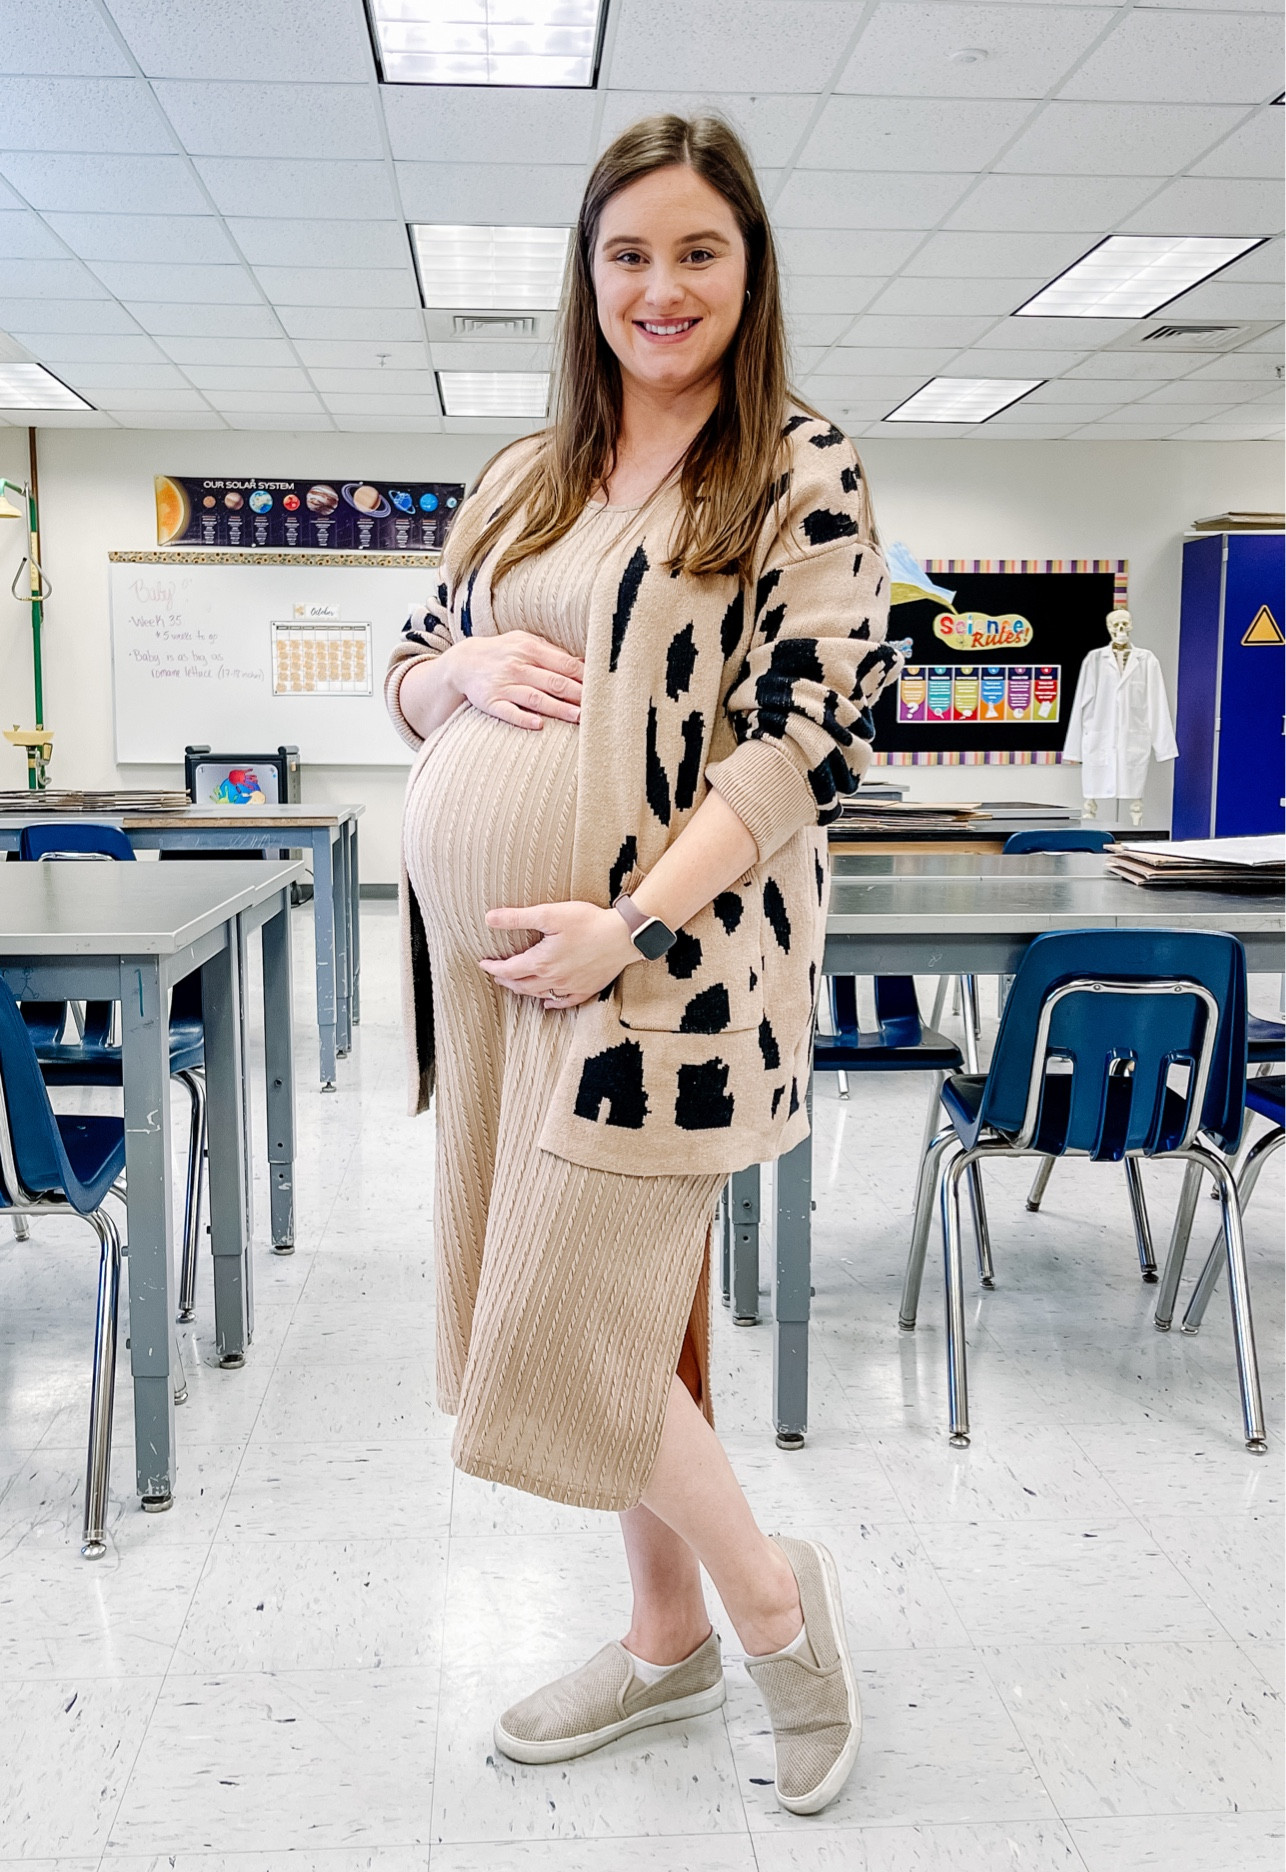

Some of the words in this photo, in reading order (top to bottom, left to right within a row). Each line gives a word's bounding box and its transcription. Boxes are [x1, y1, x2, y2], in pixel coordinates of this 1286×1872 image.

[203, 480, 224, 489] OUR
[225, 481, 257, 490] SOLAR
[258, 482, 295, 490] SYSTEM
[310, 606, 335, 616] October
[168, 615, 182, 626] 35
[971, 627, 1030, 648] Rules!
[133, 649, 161, 665] Baby
